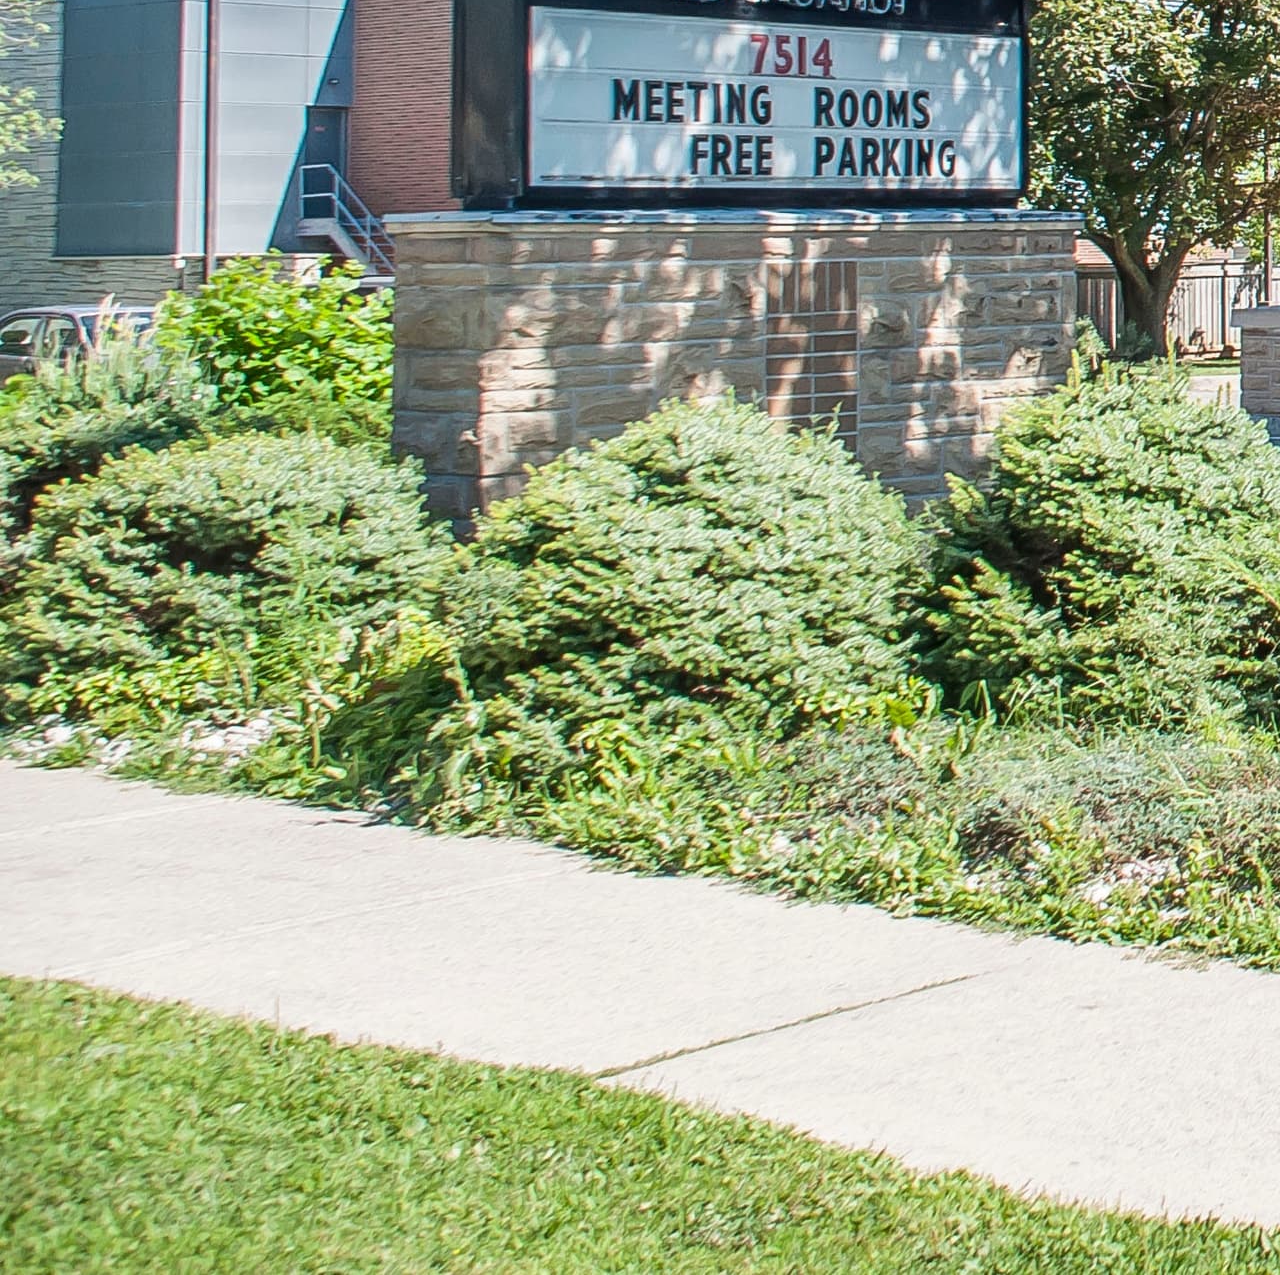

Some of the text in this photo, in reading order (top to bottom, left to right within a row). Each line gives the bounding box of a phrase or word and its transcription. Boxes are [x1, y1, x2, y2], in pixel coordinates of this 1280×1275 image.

[750, 34, 834, 77] 7514
[612, 78, 932, 129] MEETING ROOMS
[690, 133, 956, 178] FREE PARKING
